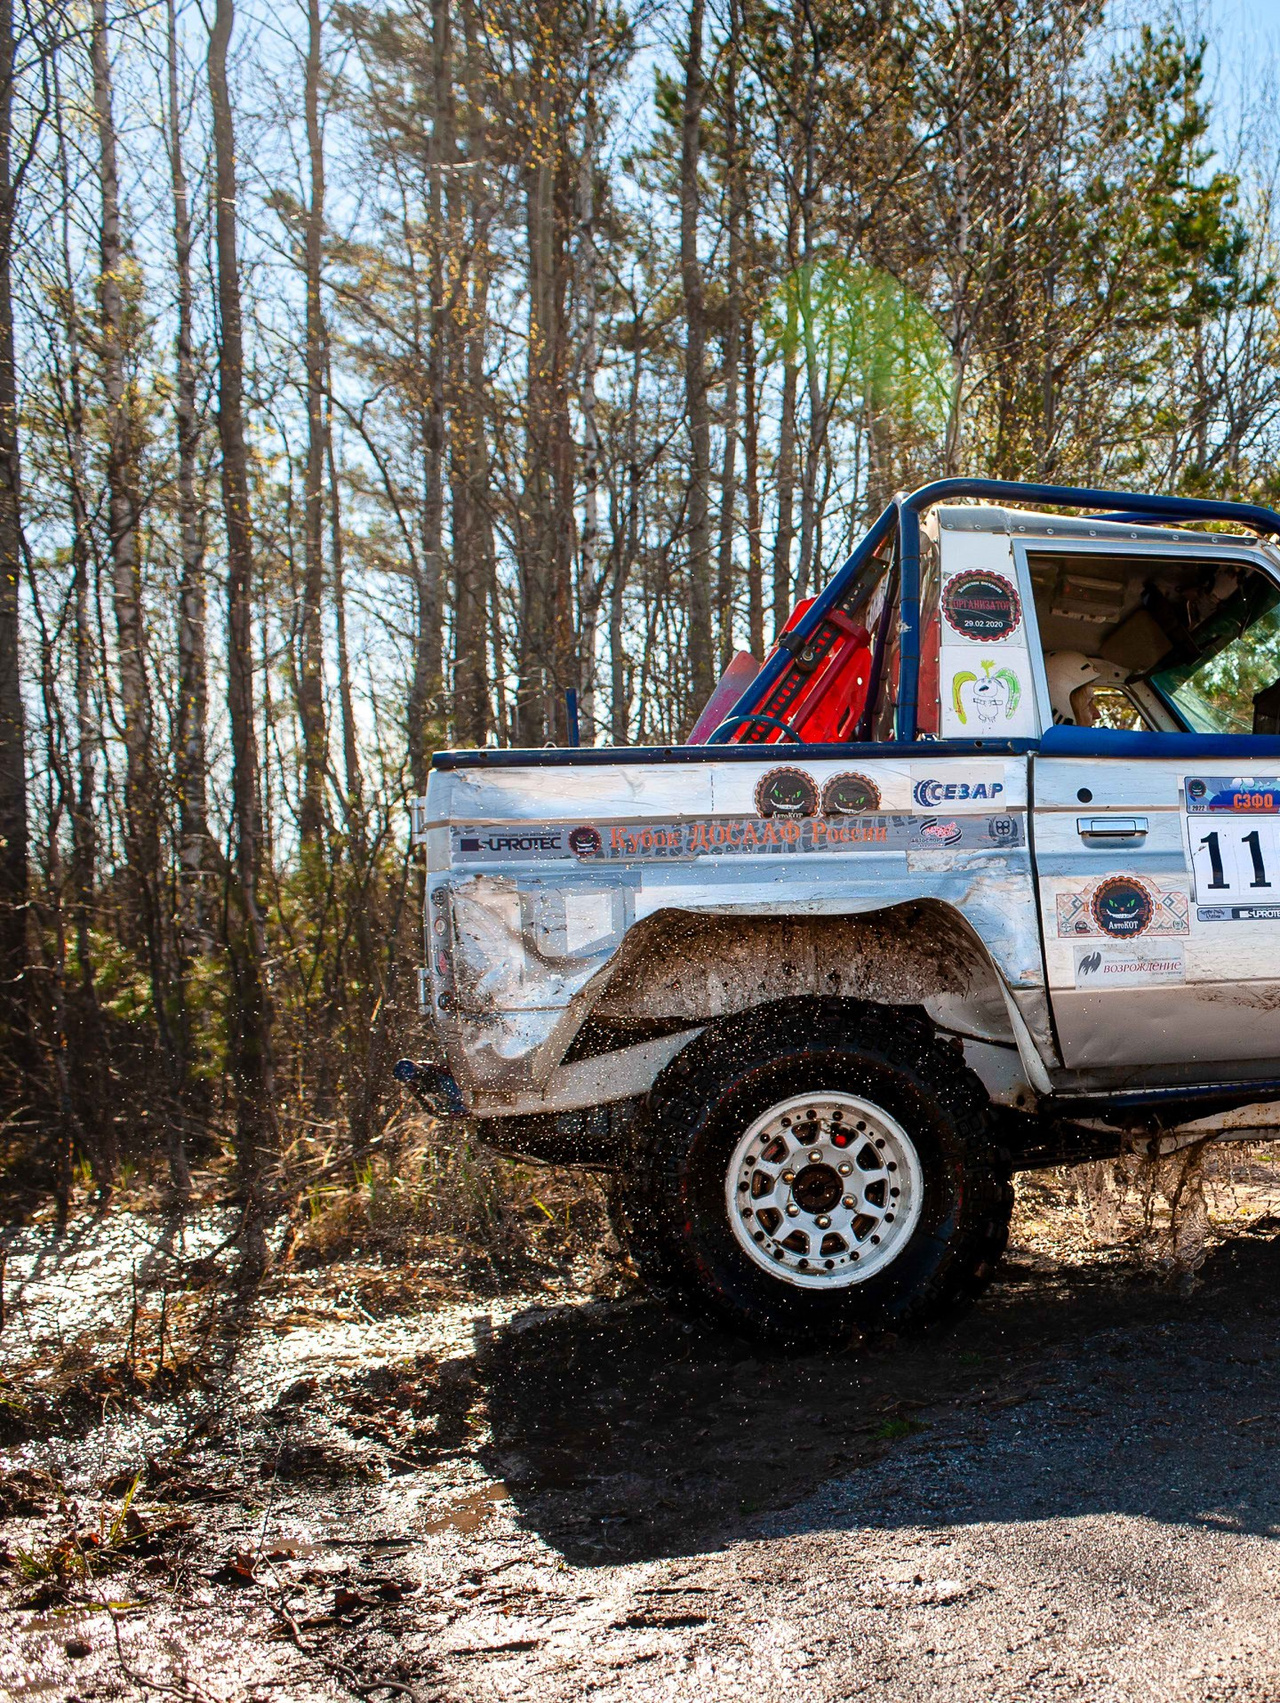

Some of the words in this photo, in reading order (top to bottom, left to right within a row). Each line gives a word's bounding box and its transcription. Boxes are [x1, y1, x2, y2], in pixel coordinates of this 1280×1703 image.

[964, 620, 1004, 628] 29.02.2020
[927, 782, 1004, 801] СЕЗАР
[1233, 793, 1273, 810] СЗФО
[479, 836, 562, 852] SUPROTEC
[610, 827, 680, 853] Кубок
[690, 820, 801, 851] ДОСААФ
[811, 822, 888, 844] России
